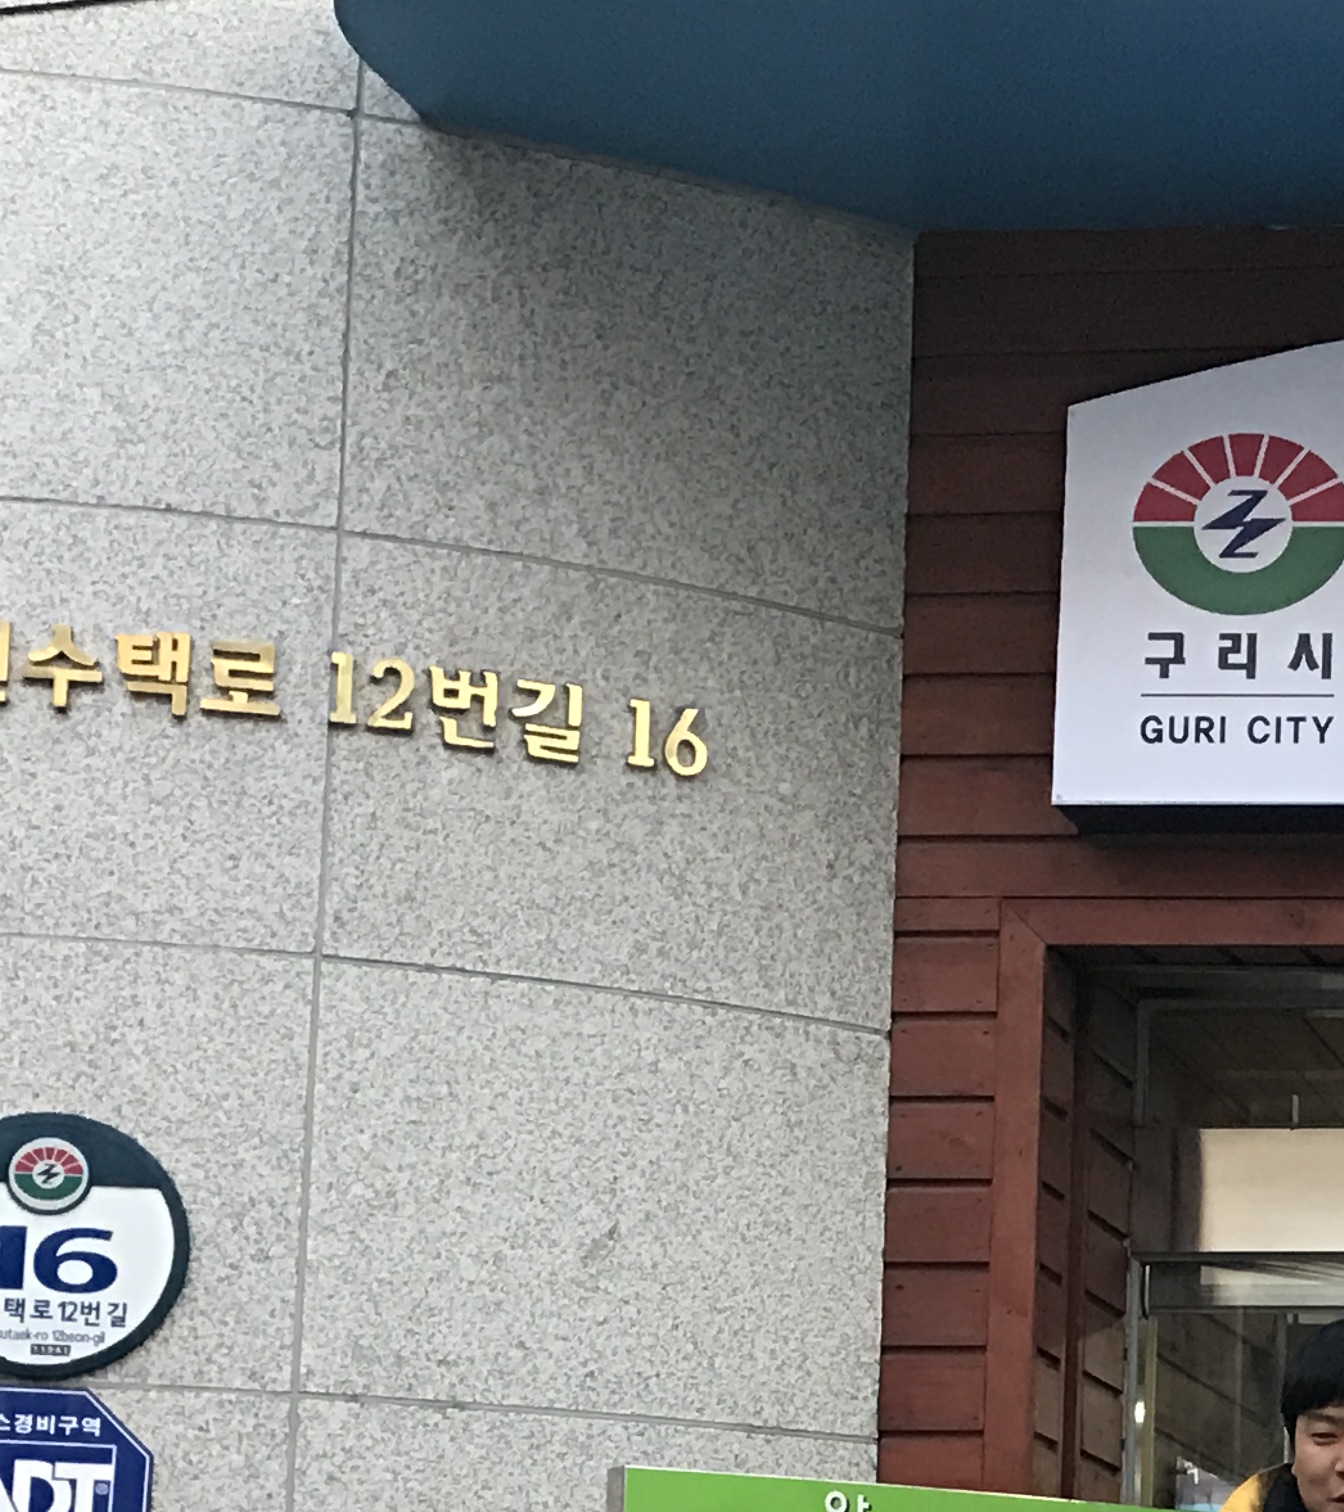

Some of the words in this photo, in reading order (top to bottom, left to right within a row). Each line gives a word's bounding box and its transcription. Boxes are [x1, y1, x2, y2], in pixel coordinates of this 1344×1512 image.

[1144, 632, 1334, 680] 구리시
[0, 620, 281, 718] 수택로
[329, 650, 582, 764] 12번길
[628, 698, 708, 777] 16
[1140, 715, 1227, 745] GURI
[1247, 714, 1334, 744] CITY
